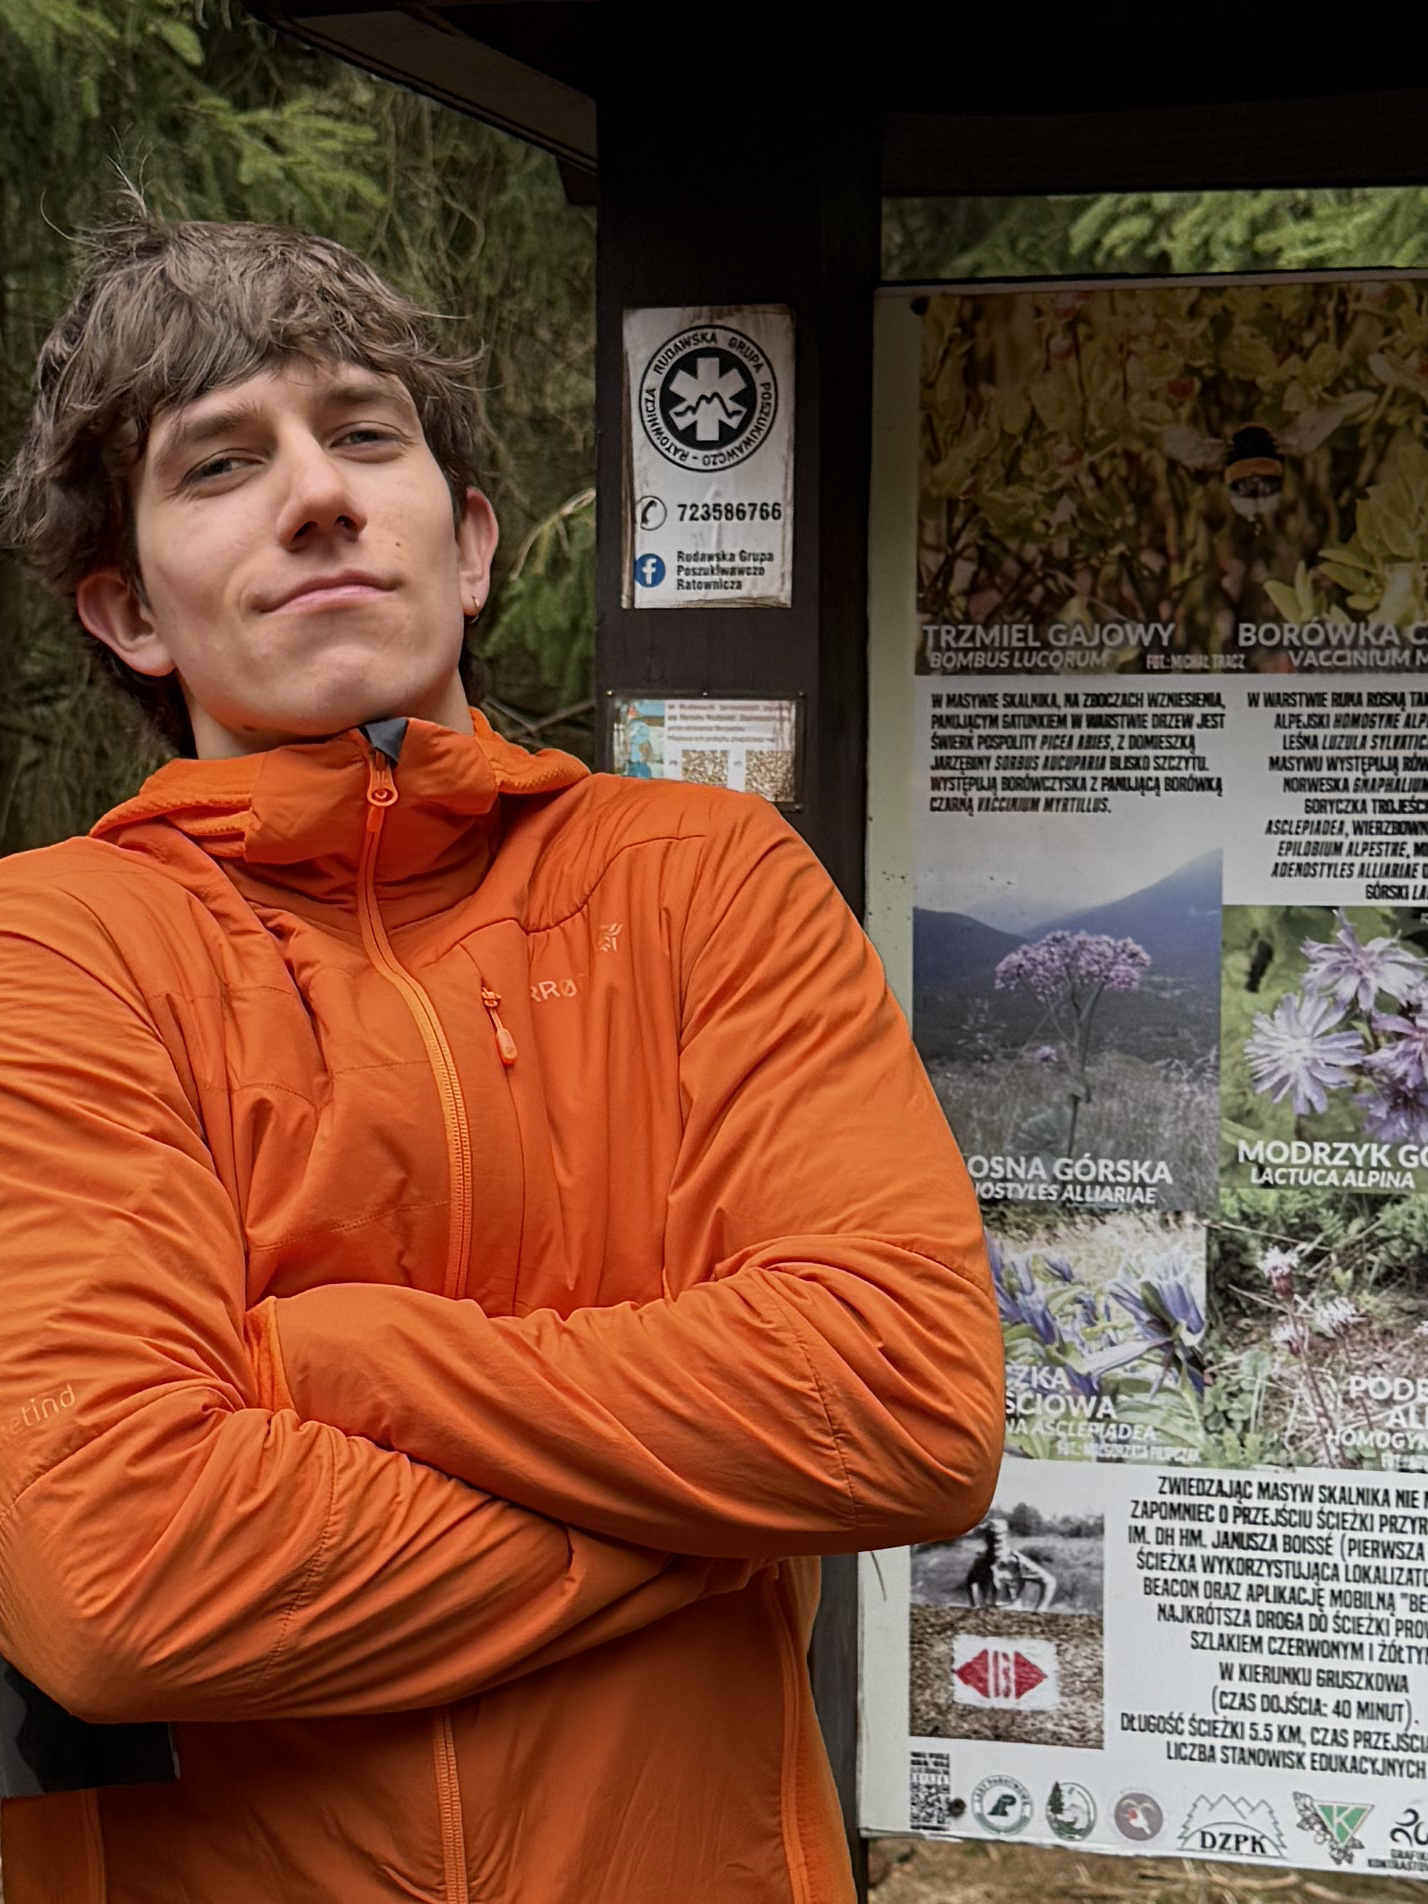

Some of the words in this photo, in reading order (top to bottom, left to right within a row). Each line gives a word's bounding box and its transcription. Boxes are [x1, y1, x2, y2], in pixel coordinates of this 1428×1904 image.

[653, 332, 717, 375] RUDAWSKA
[728, 337, 763, 373] GRUPA
[646, 387, 689, 460] RATOWNICZA
[703, 382, 771, 466] POSZUKIWAWCZO
[677, 502, 782, 521] 723586766
[677, 579, 742, 590] Ratownicza
[923, 625, 1040, 647] TRZMIEL
[1048, 623, 1175, 647] GAJOWY
[1239, 617, 1399, 646] BORÓWKA
[930, 652, 1010, 668] BOMBUS
[1013, 651, 1108, 667] LUCORUM
[1289, 650, 1411, 666] VACCINIUM
[1239, 1141, 1390, 1169] MODRZYK
[969, 1157, 1044, 1182] OSNA
[1054, 1153, 1172, 1184] GÓRSKA
[1250, 1168, 1339, 1187] LACTUCA
[1344, 1170, 1414, 1188] ALPINA
[977, 1184, 1058, 1202] OSTYLES
[1061, 1185, 1156, 1204] ALLIARIAE
[1158, 1477, 1252, 1504] ZWIEDZAJĄC
[1257, 1482, 1314, 1503] MASYW
[1318, 1485, 1390, 1507] SKALNIKA
[1396, 1489, 1418, 1508] NIE
[1200, 1830, 1266, 1854] DZPK
